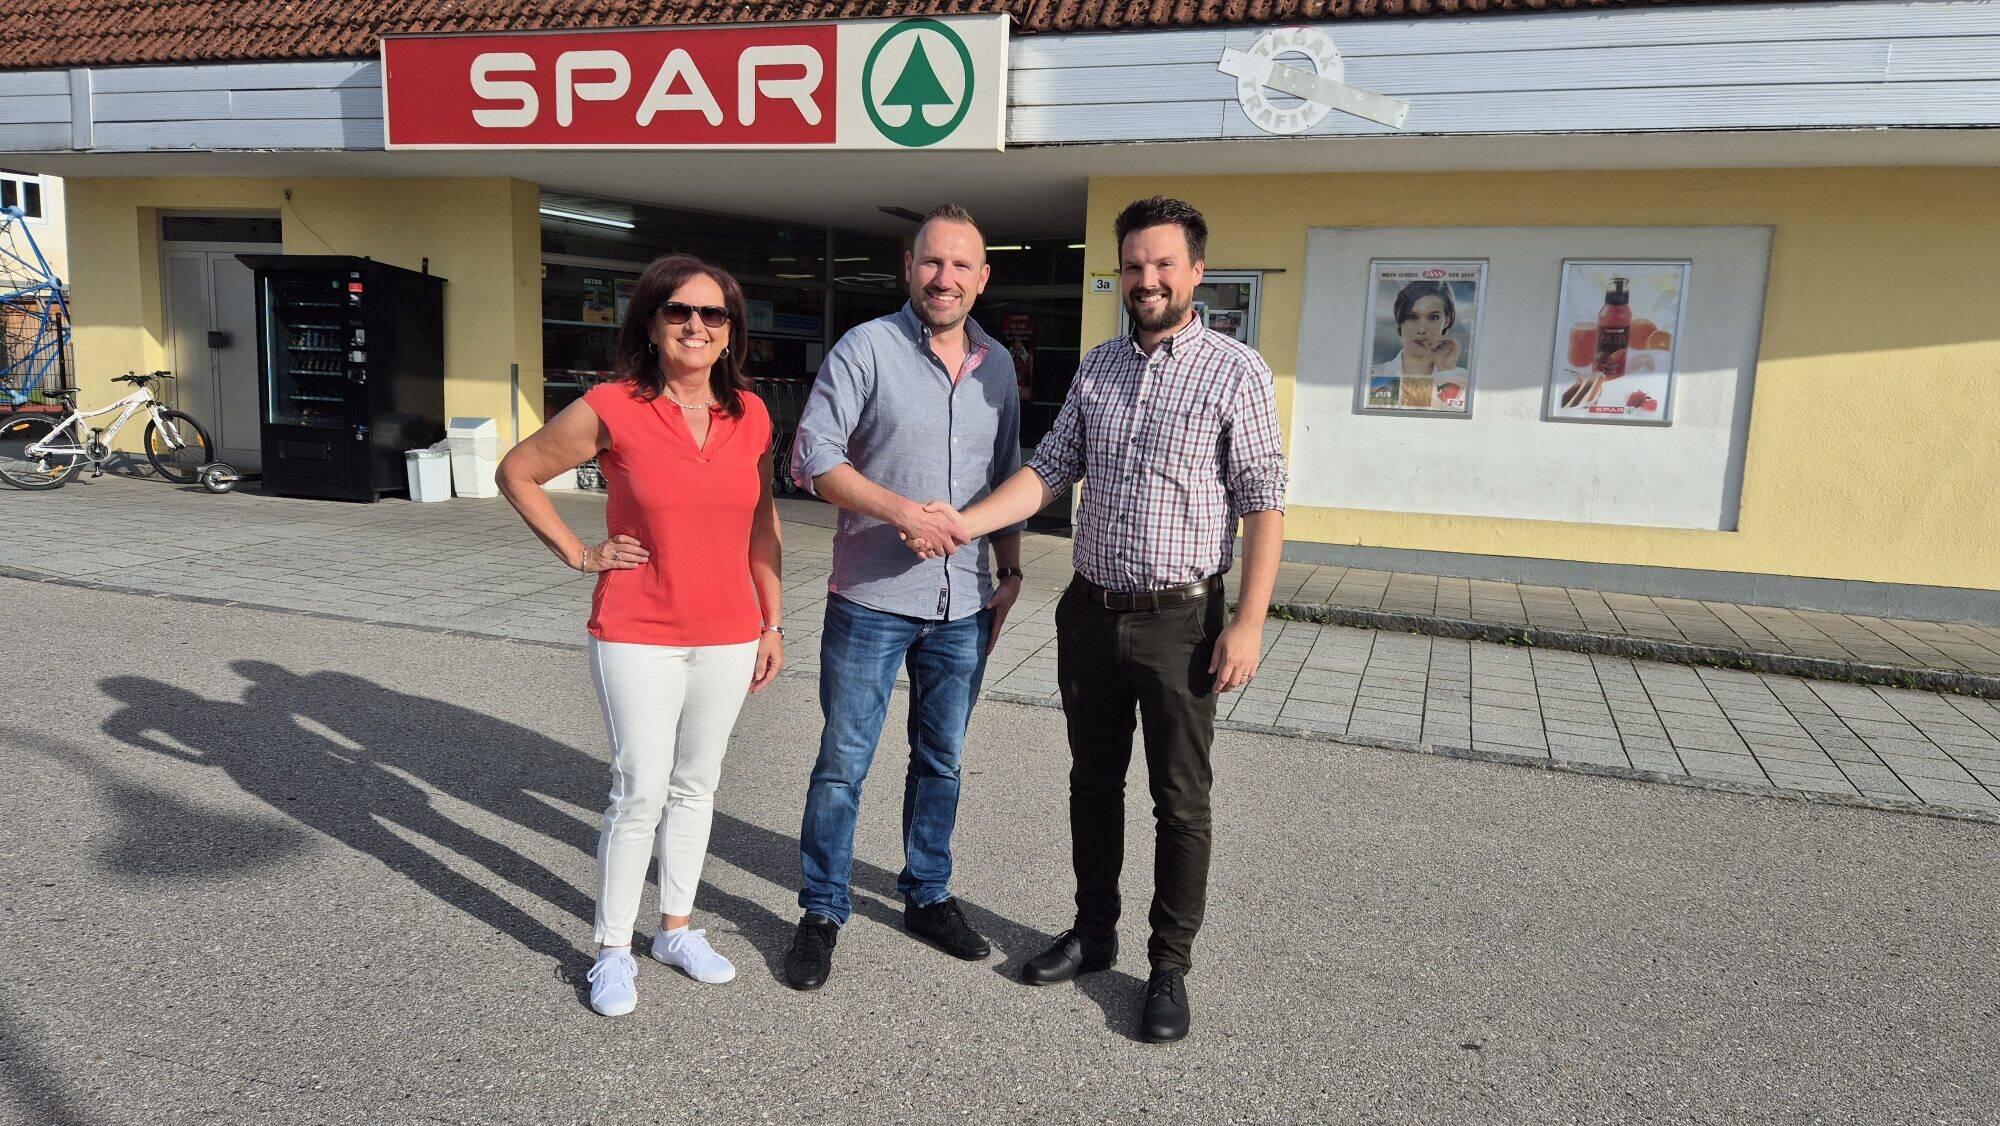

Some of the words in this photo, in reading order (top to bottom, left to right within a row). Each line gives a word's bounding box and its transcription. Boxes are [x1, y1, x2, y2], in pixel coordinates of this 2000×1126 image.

[469, 43, 824, 128] SPAR
[1243, 77, 1319, 128] TRAFIK
[1097, 279, 1109, 289] 3a
